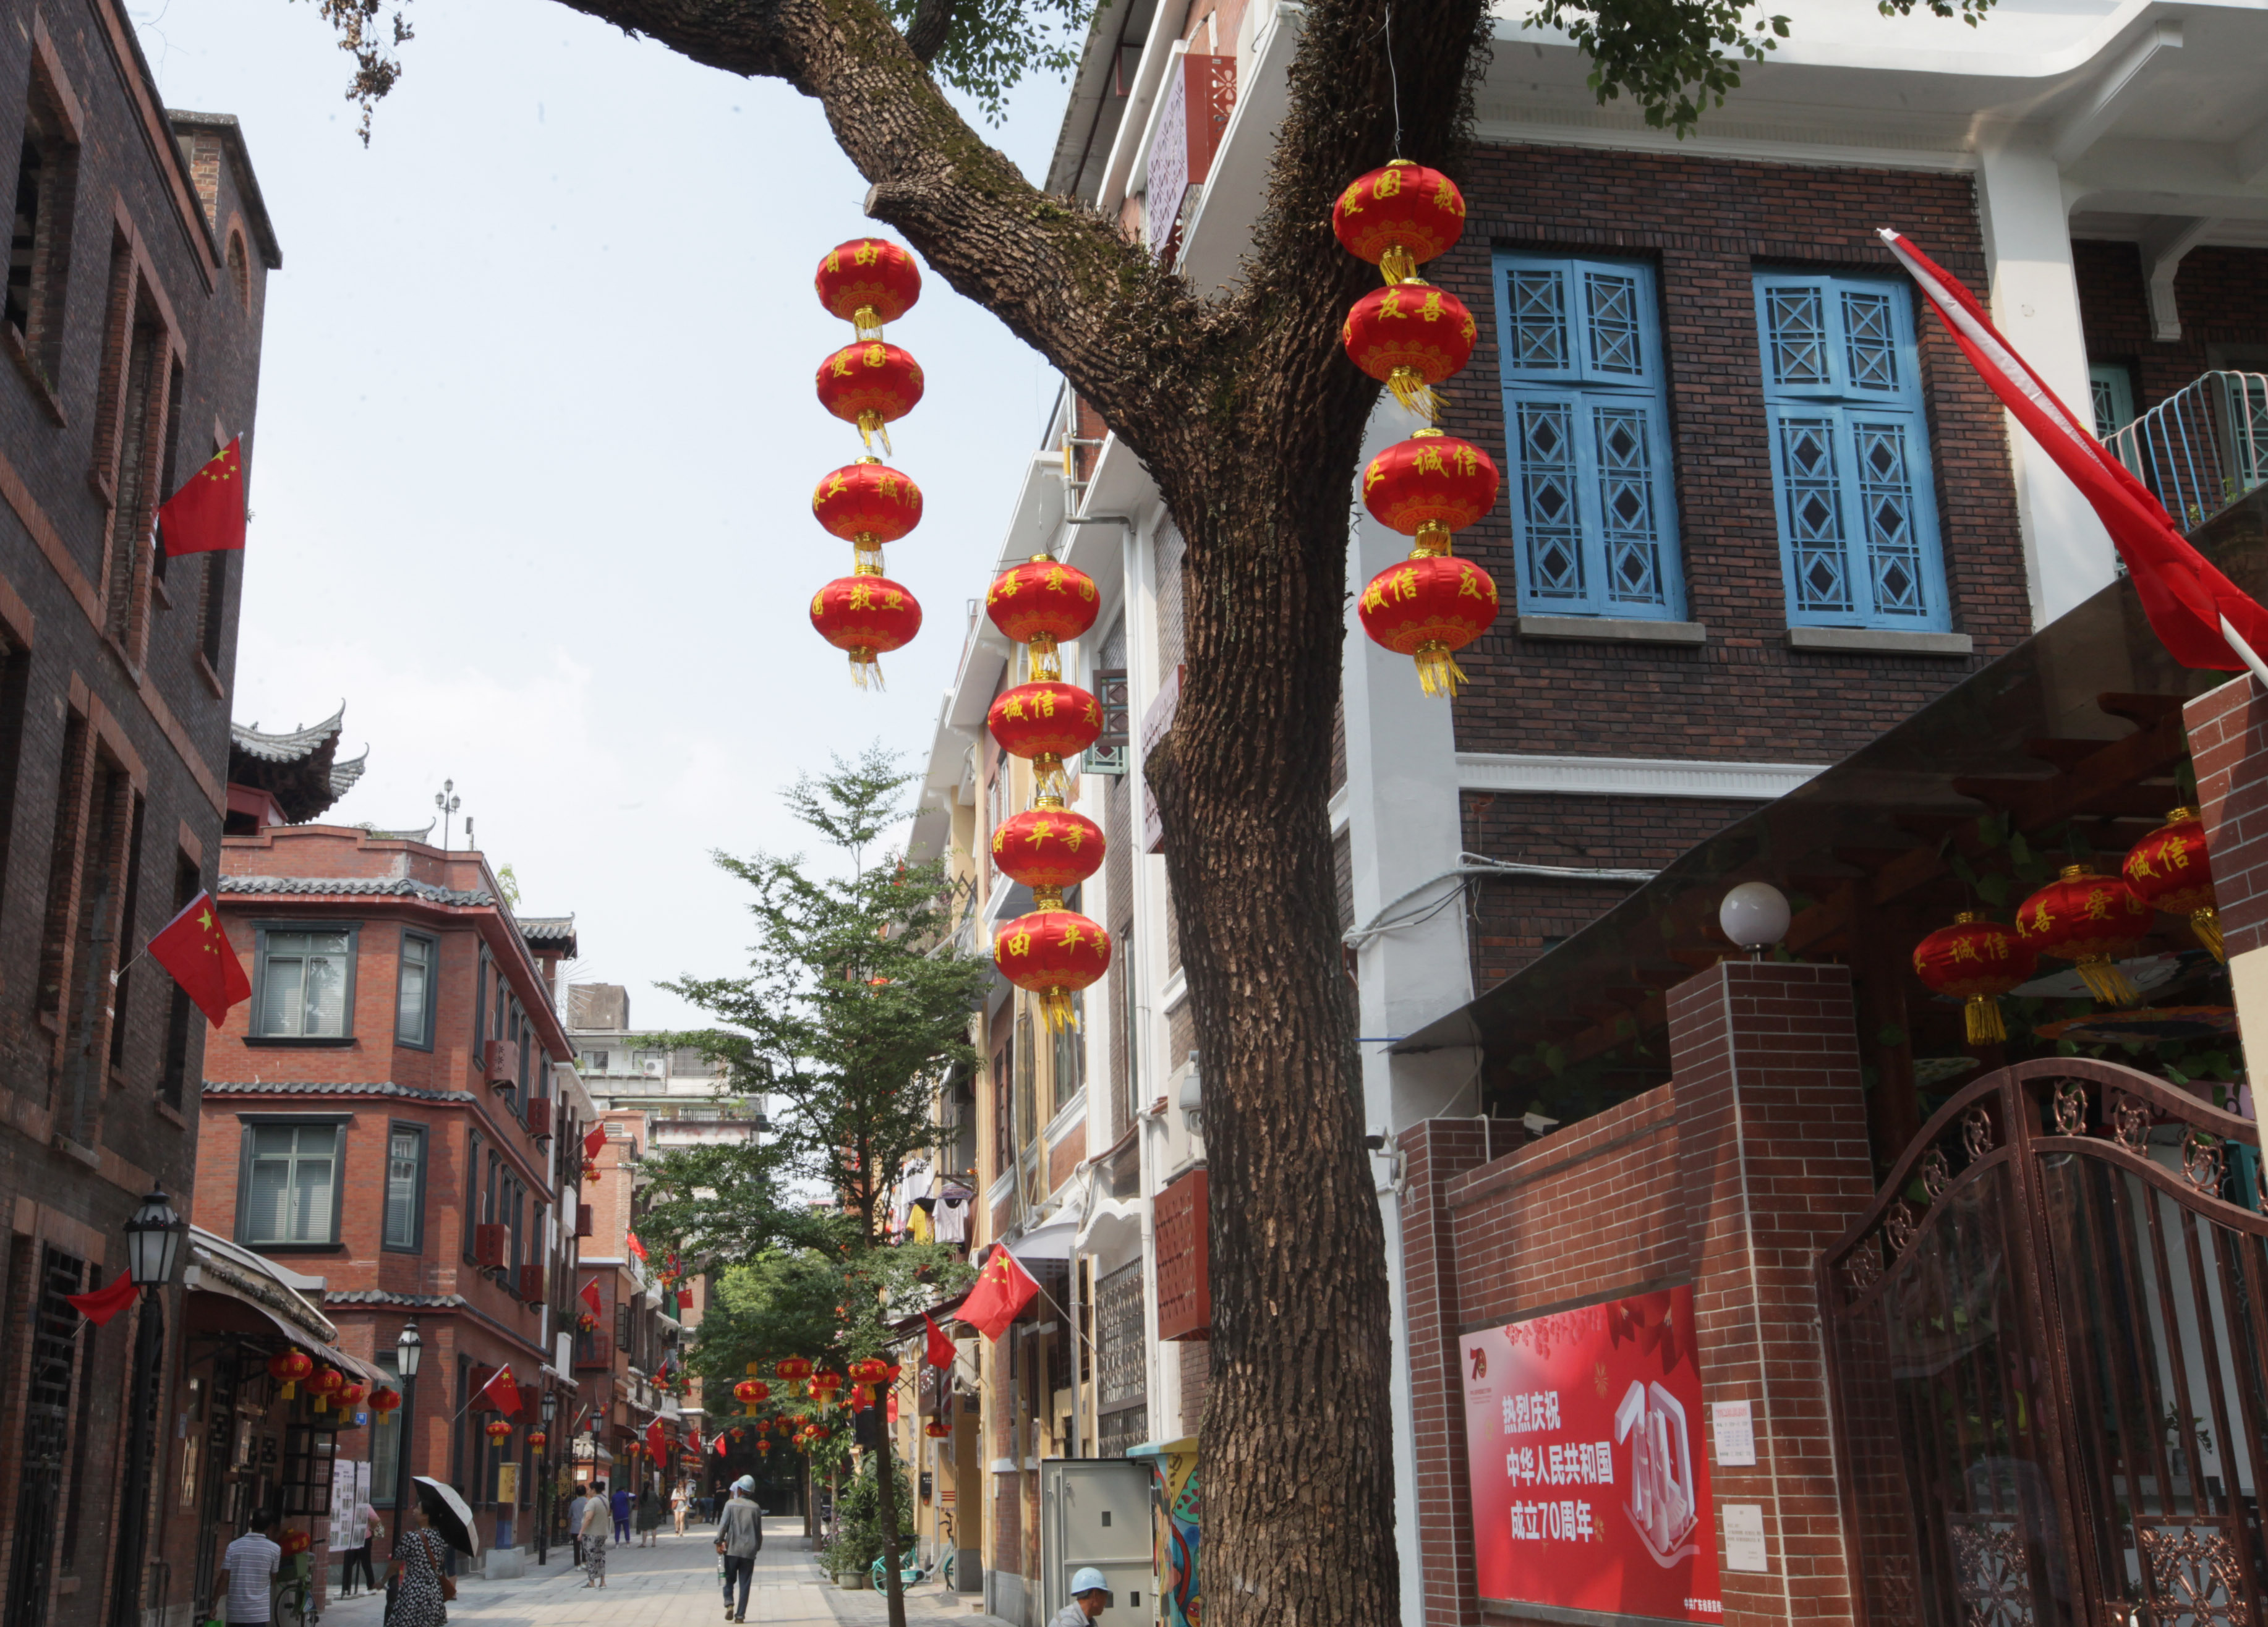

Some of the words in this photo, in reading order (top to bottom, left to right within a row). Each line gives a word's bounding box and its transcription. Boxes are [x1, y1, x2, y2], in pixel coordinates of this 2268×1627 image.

[1342, 169, 1401, 217] 爱国
[826, 242, 879, 273] 自由
[1378, 288, 1446, 322] 友善
[831, 344, 886, 378] 爱国
[1412, 444, 1478, 479] 诚信
[875, 475, 918, 509] 诚信
[850, 583, 905, 611] 敬业
[1044, 567, 1095, 603] 爱国
[1363, 567, 1420, 614] 诚信
[1003, 690, 1057, 723] 诚信
[1025, 821, 1086, 853] 平等
[2128, 836, 2190, 882] 诚信
[1058, 925, 1107, 959] 平等
[1949, 932, 2008, 964] 诚信
[1502, 1390, 1561, 1434] 热烈庆祝
[1506, 1442, 1614, 1488] 中华人民共和国
[1511, 1500, 1594, 1544] 成立70周年
